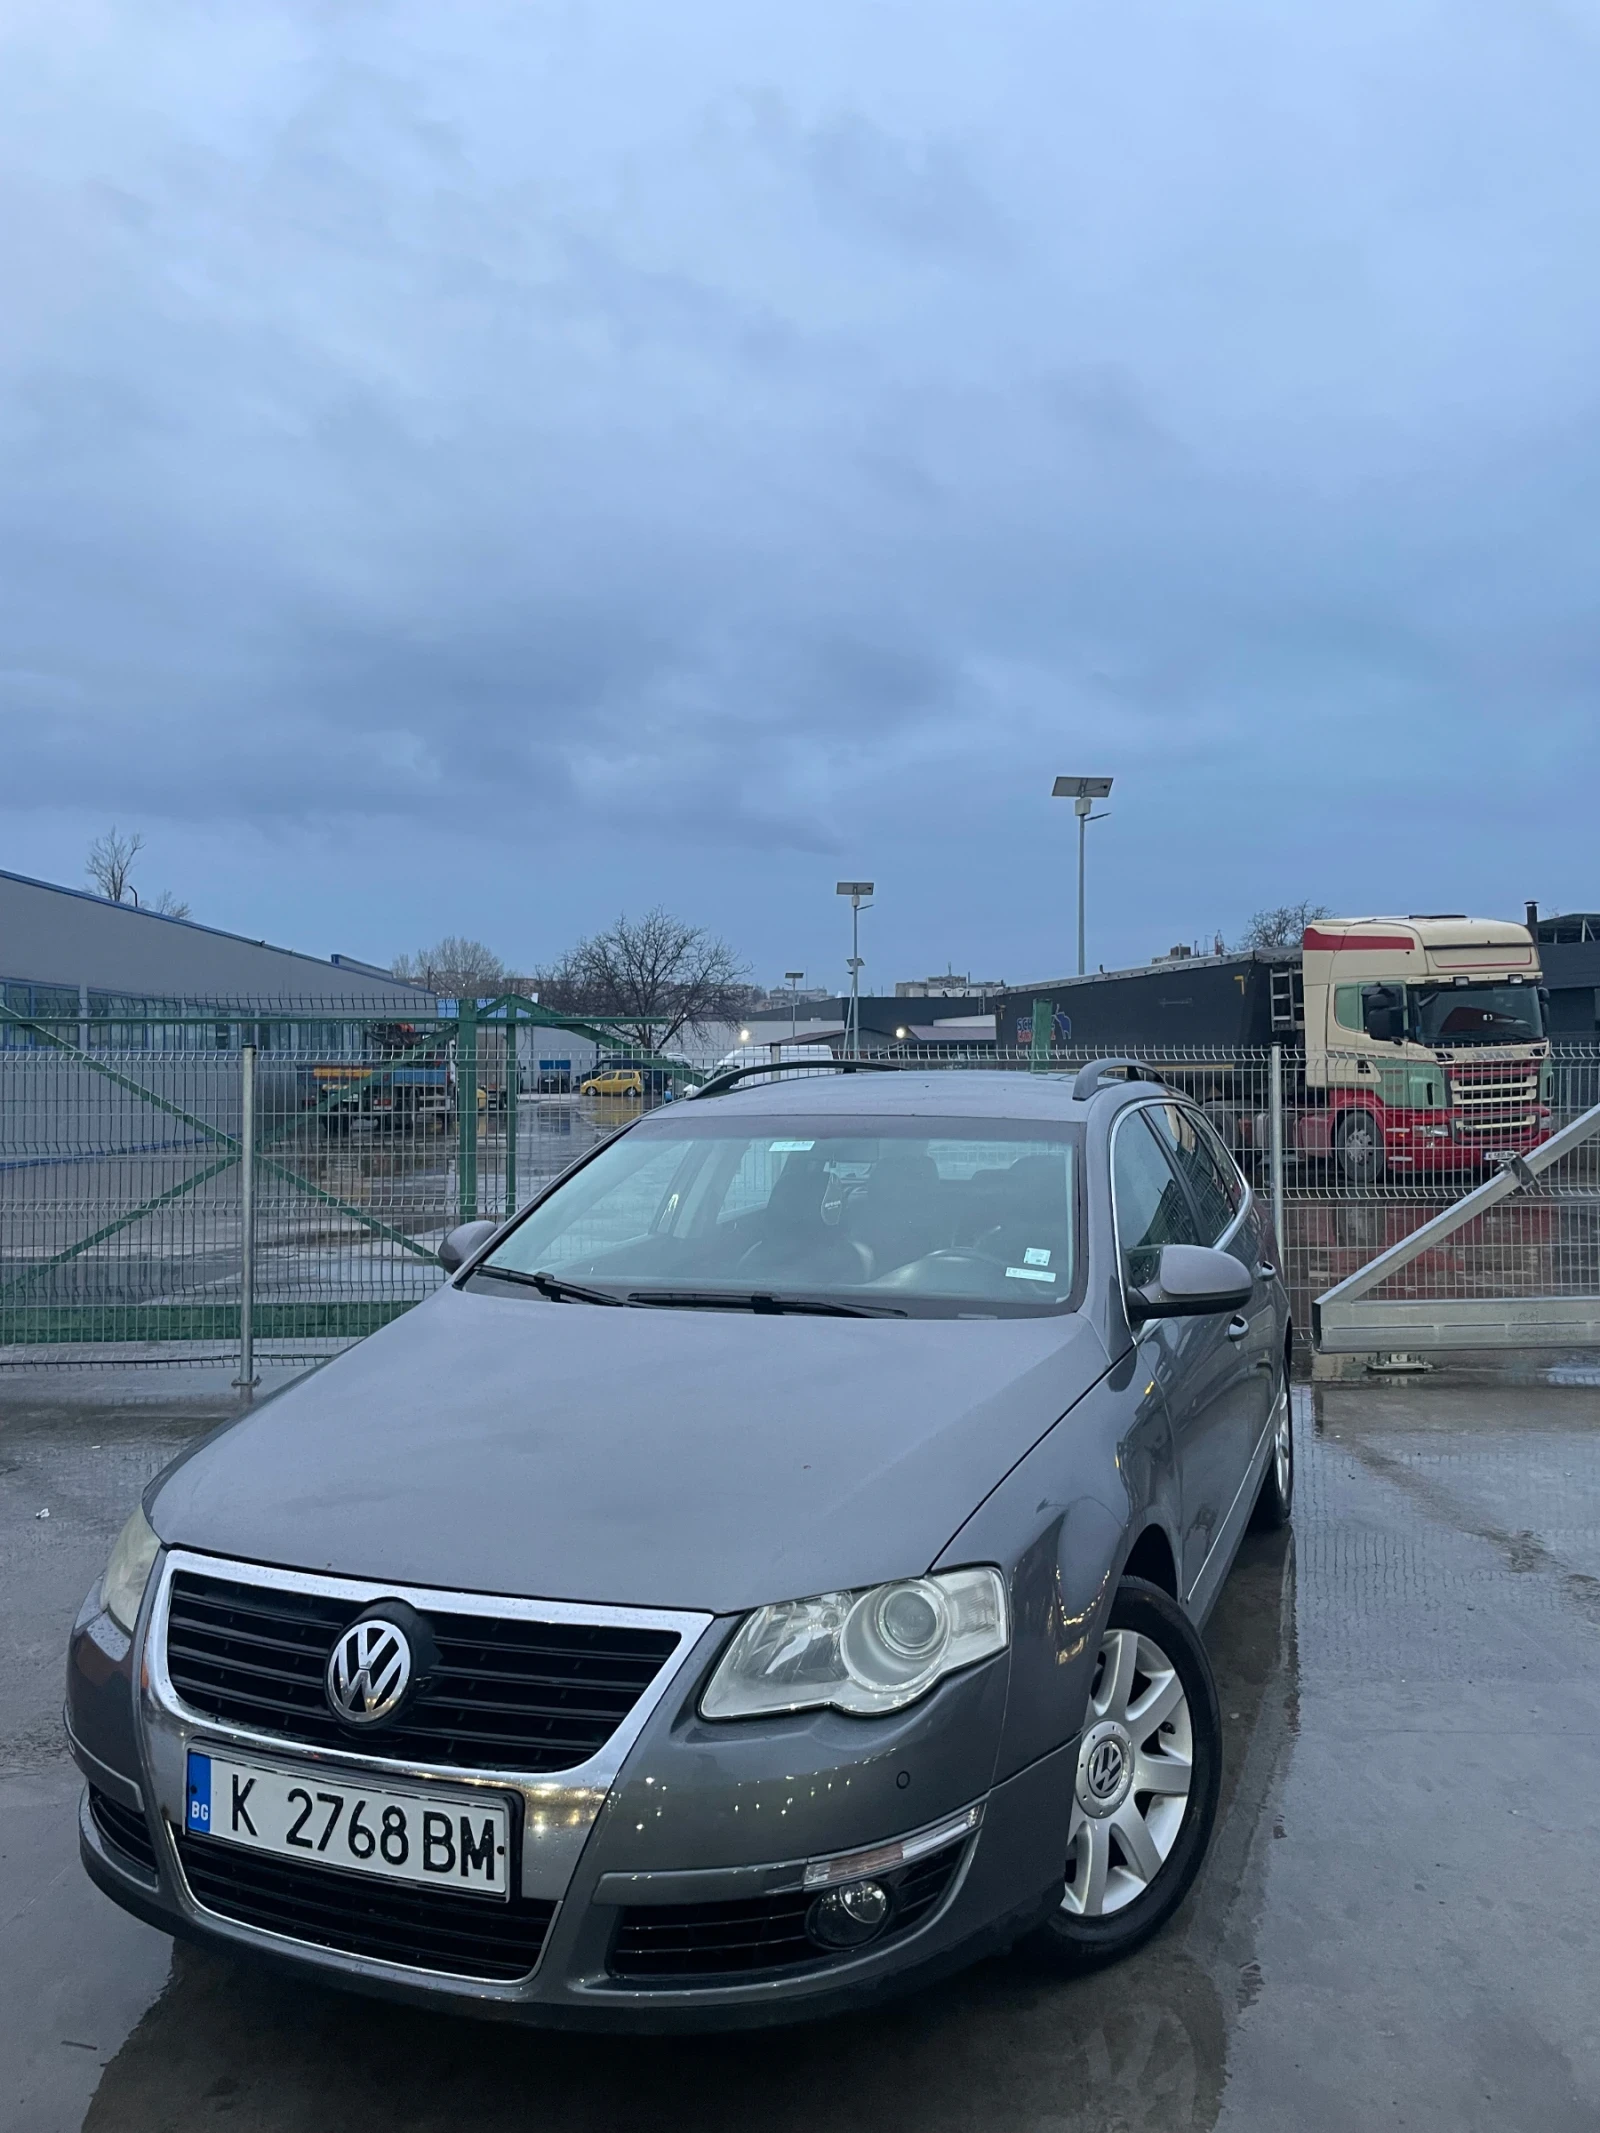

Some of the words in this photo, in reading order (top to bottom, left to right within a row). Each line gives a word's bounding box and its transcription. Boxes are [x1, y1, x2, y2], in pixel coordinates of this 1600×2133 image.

[328, 1620, 410, 1723] VW
[191, 1800, 209, 1821] BG
[231, 1773, 258, 1837] K
[286, 1788, 409, 1866] 2768
[422, 1811, 496, 1881] BM
